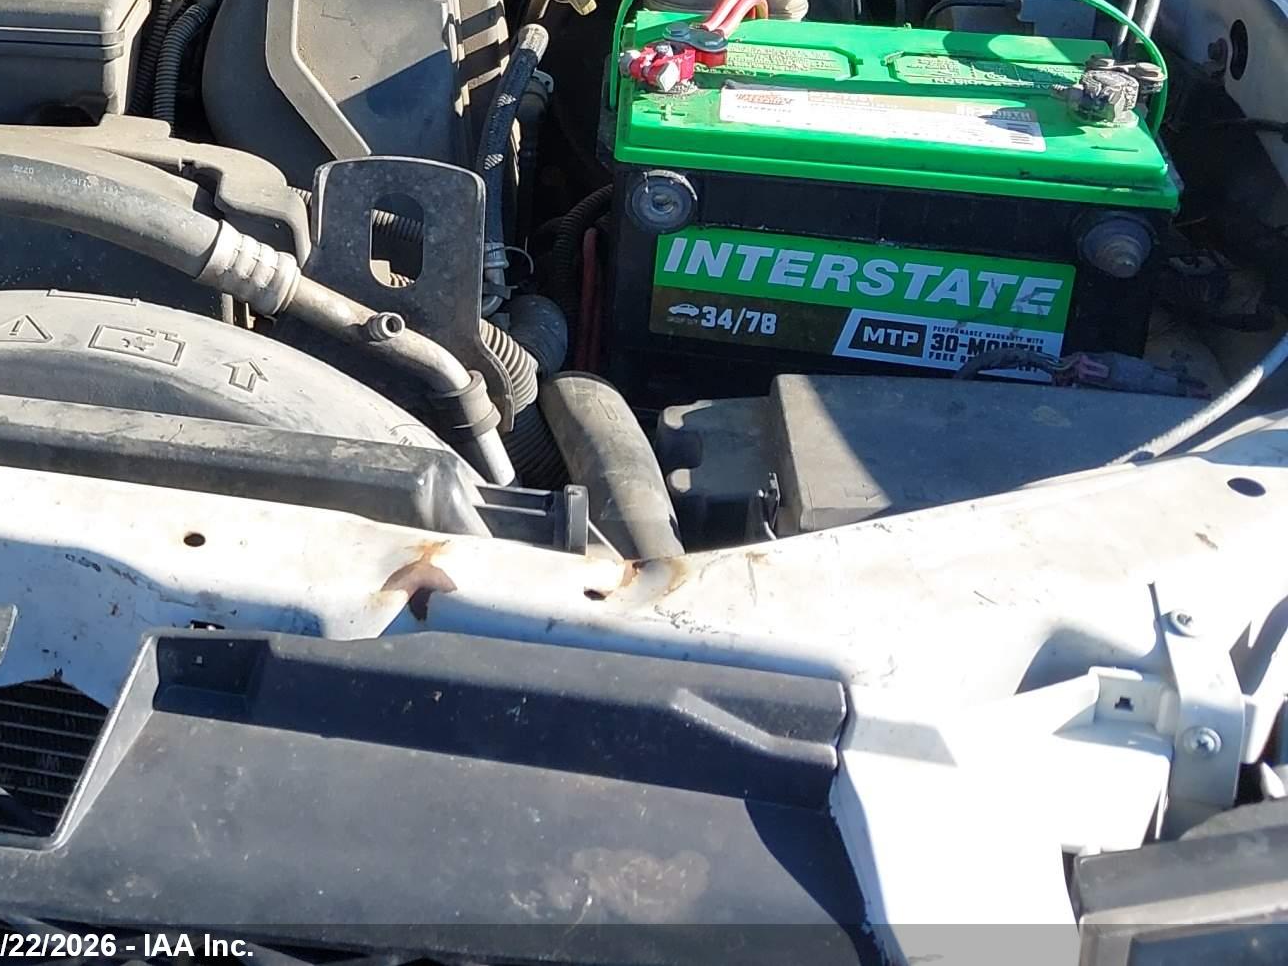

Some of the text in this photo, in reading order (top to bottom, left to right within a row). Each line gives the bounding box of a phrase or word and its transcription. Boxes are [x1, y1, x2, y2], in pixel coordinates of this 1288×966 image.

[663, 237, 1064, 316] INTERSTATE
[700, 305, 778, 335] 34/78
[862, 325, 919, 348] MTP
[933, 325, 982, 337] PERFORMANCE
[985, 332, 1025, 342] WARRANTY
[928, 351, 956, 362] FREE
